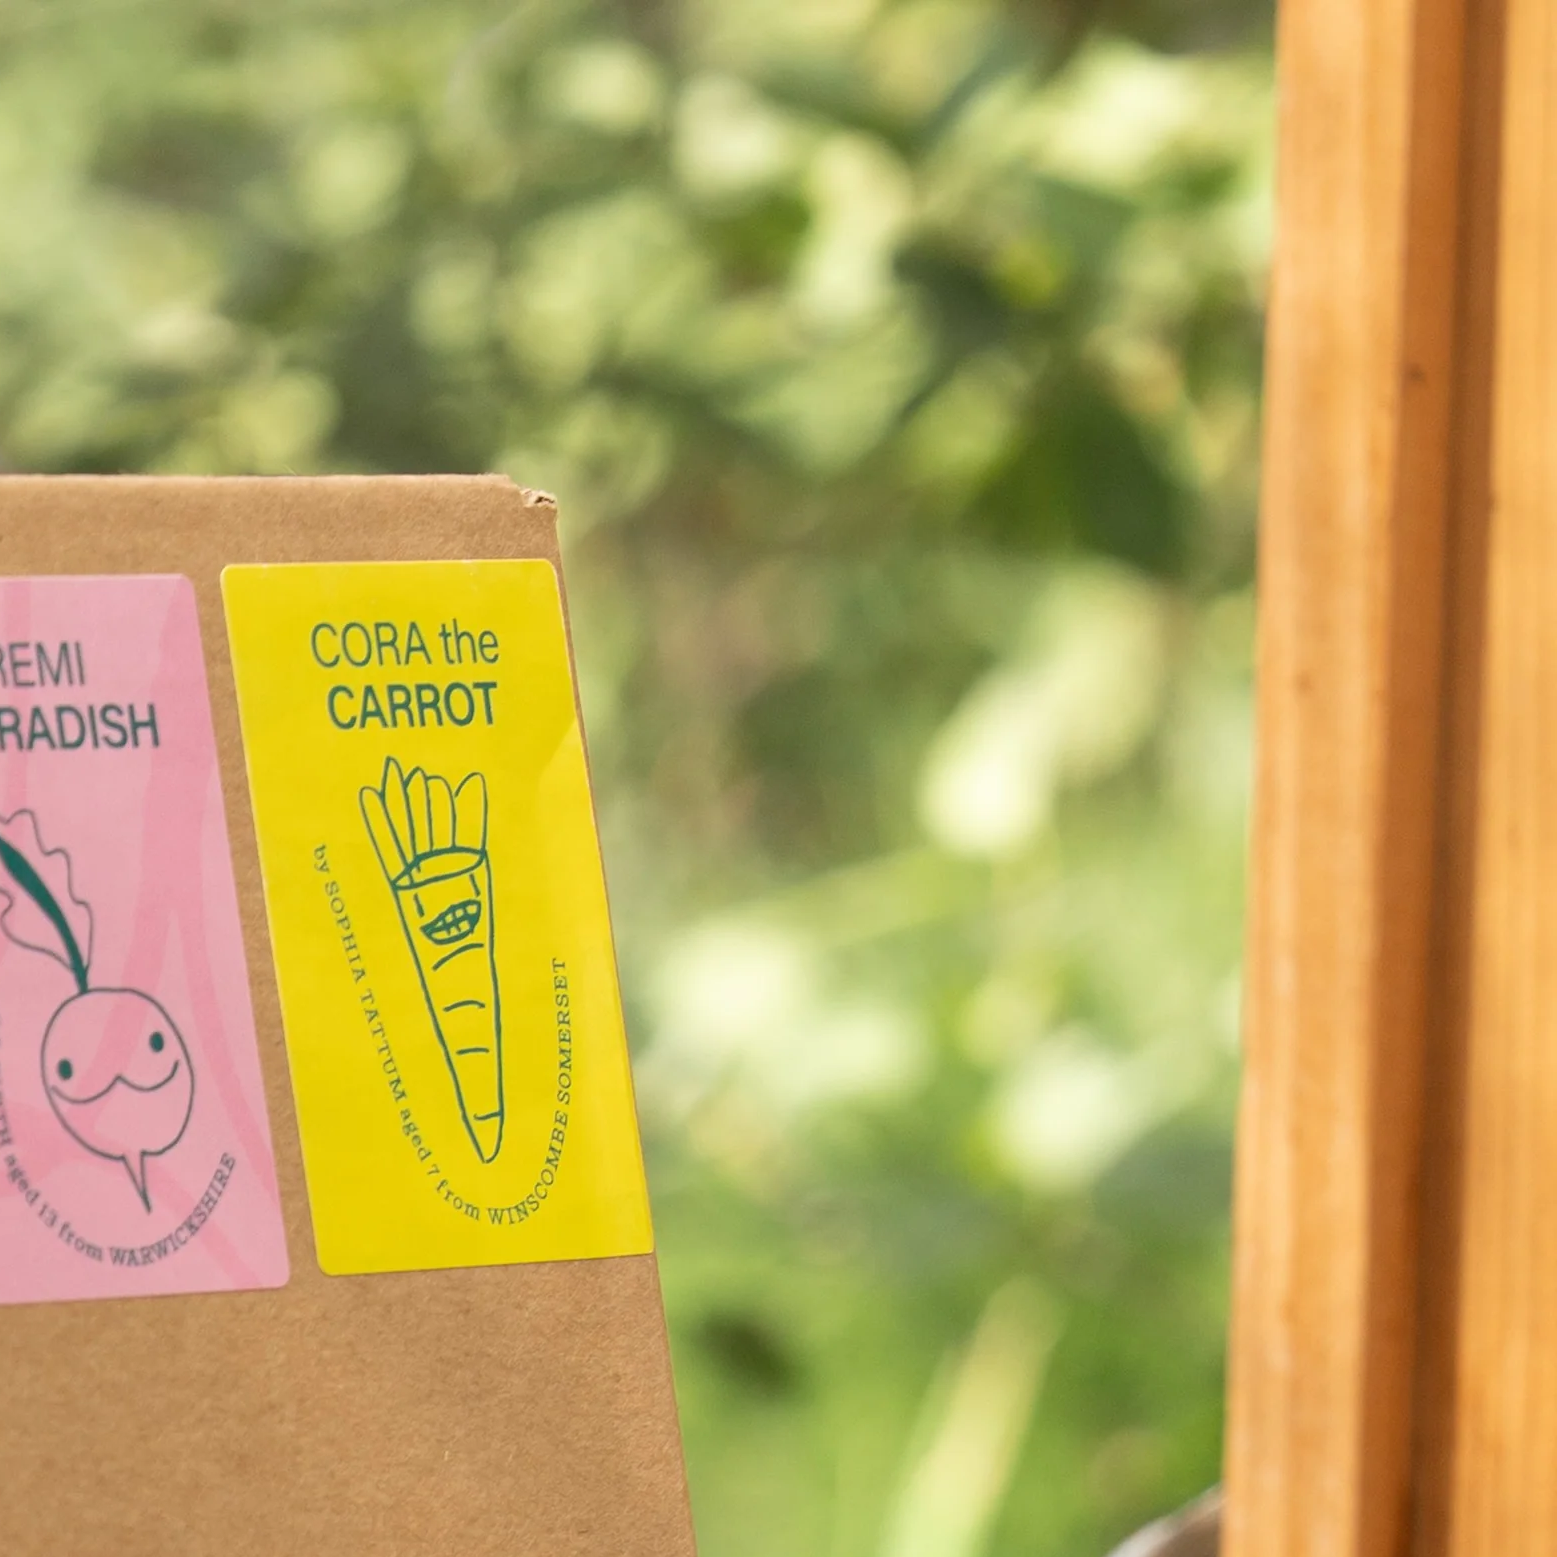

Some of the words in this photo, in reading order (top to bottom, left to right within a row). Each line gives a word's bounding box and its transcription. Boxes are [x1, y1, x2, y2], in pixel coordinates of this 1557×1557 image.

[311, 621, 432, 668] CORA
[438, 618, 499, 664] the
[327, 681, 498, 730] CARROT
[313, 844, 330, 874] by
[324, 880, 367, 985] SOPHIA
[359, 989, 408, 1103] TATTUM
[400, 1108, 433, 1164] aged
[426, 1163, 441, 1177] 7
[436, 1178, 481, 1221] from
[487, 1111, 569, 1226] WINSCOMBE
[552, 957, 573, 1106] SOMERSET
[4, 1155, 40, 1208] aged
[58, 1221, 104, 1262] from
[108, 1152, 236, 1267] WARWICKSHIRE
